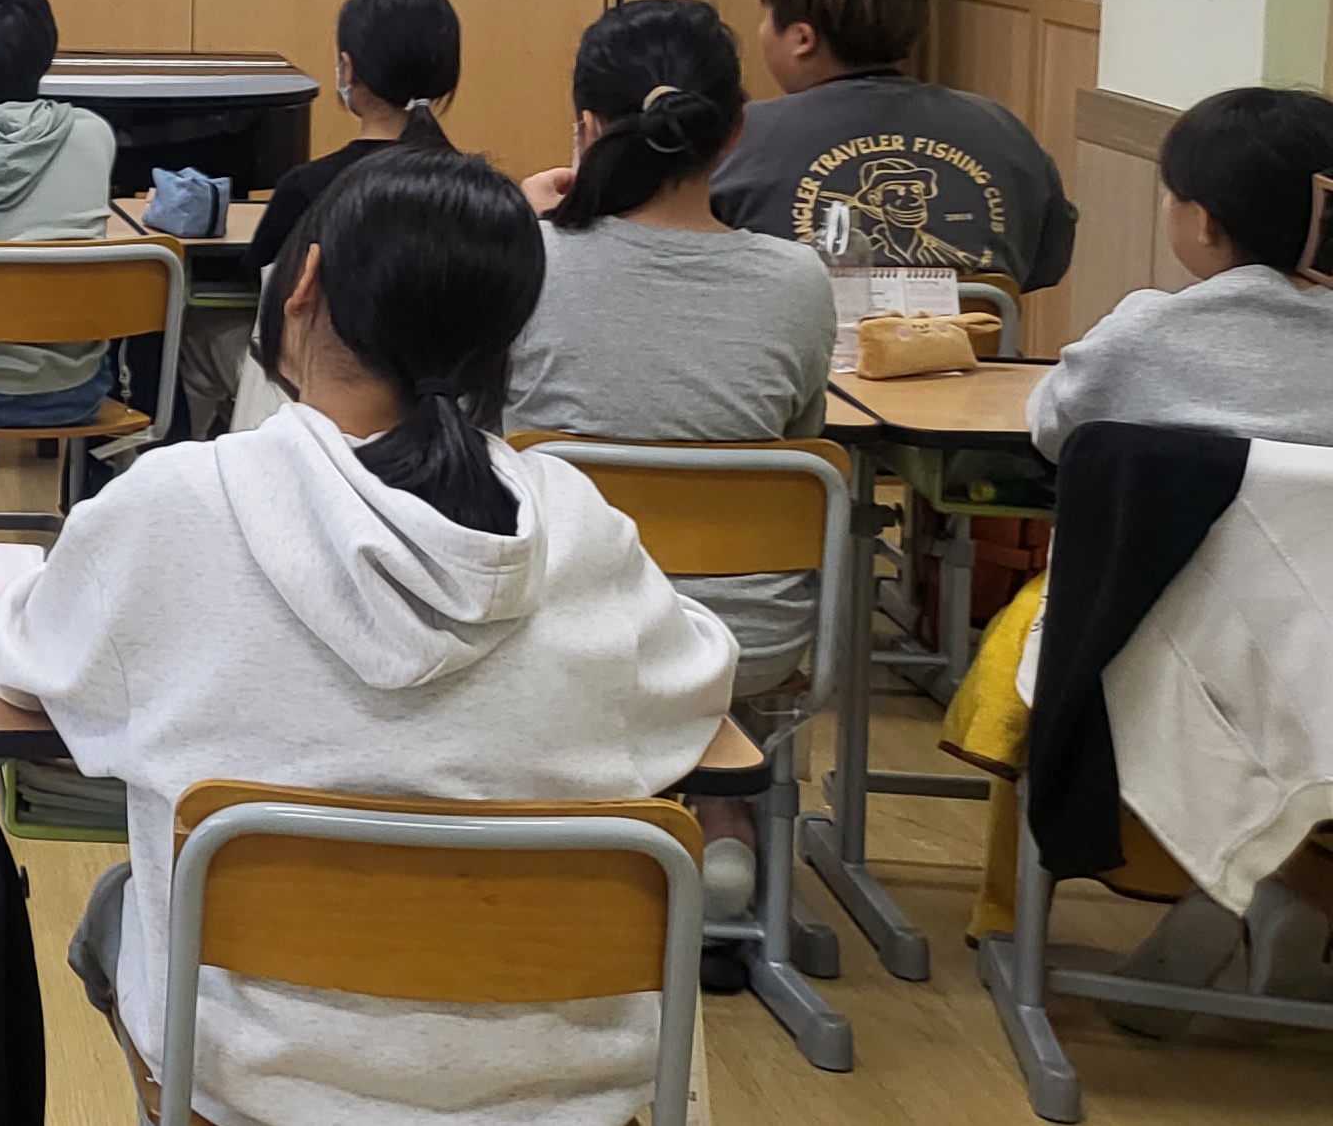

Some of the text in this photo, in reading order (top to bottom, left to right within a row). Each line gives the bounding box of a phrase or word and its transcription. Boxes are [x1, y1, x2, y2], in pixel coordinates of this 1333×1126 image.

[808, 134, 905, 176] TRAVELER
[913, 137, 991, 184] FISHING
[983, 187, 1006, 233] CLUB
